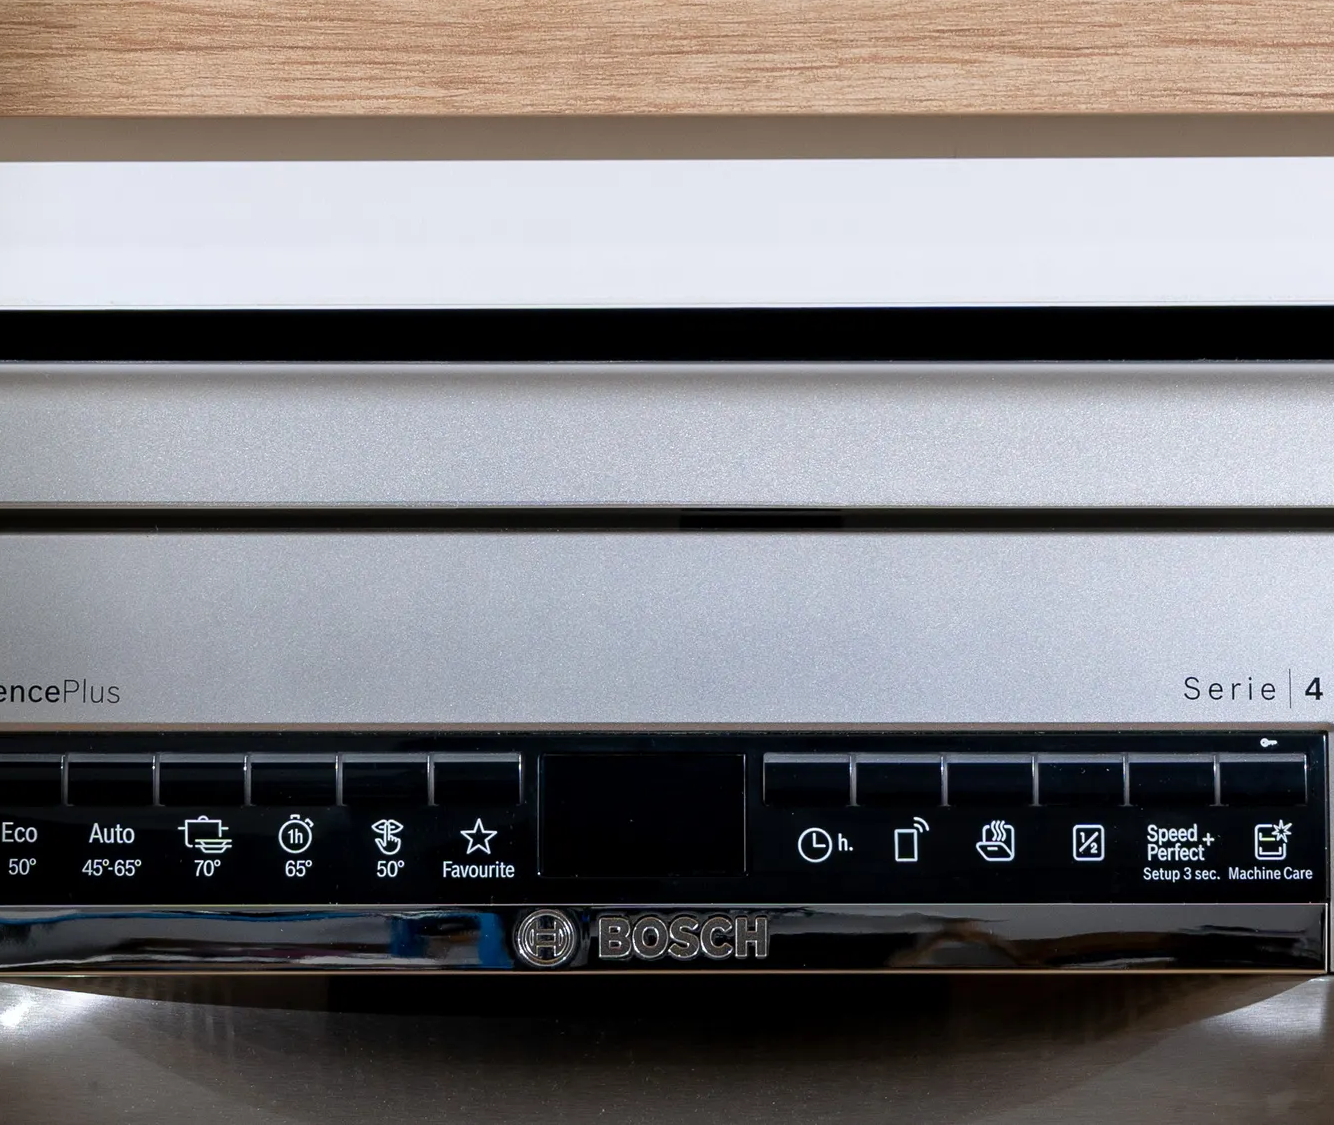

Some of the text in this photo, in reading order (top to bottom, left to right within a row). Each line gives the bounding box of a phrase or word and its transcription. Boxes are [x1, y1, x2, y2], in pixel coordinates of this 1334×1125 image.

[1184, 677, 1323, 700] Serie 4
[2, 822, 37, 843] Eco
[89, 823, 135, 844] Auto
[1147, 824, 1197, 845] Speed
[1147, 843, 1205, 861] Perfect
[9, 858, 37, 876] 50°
[194, 860, 221, 877] 70°
[285, 860, 312, 877] 65°
[377, 860, 404, 877] 50°
[443, 861, 515, 878] Favourite
[1143, 867, 1221, 882] Setup 3 sec.
[1228, 867, 1313, 880] Machine Care
[598, 916, 768, 960] BOSCH
